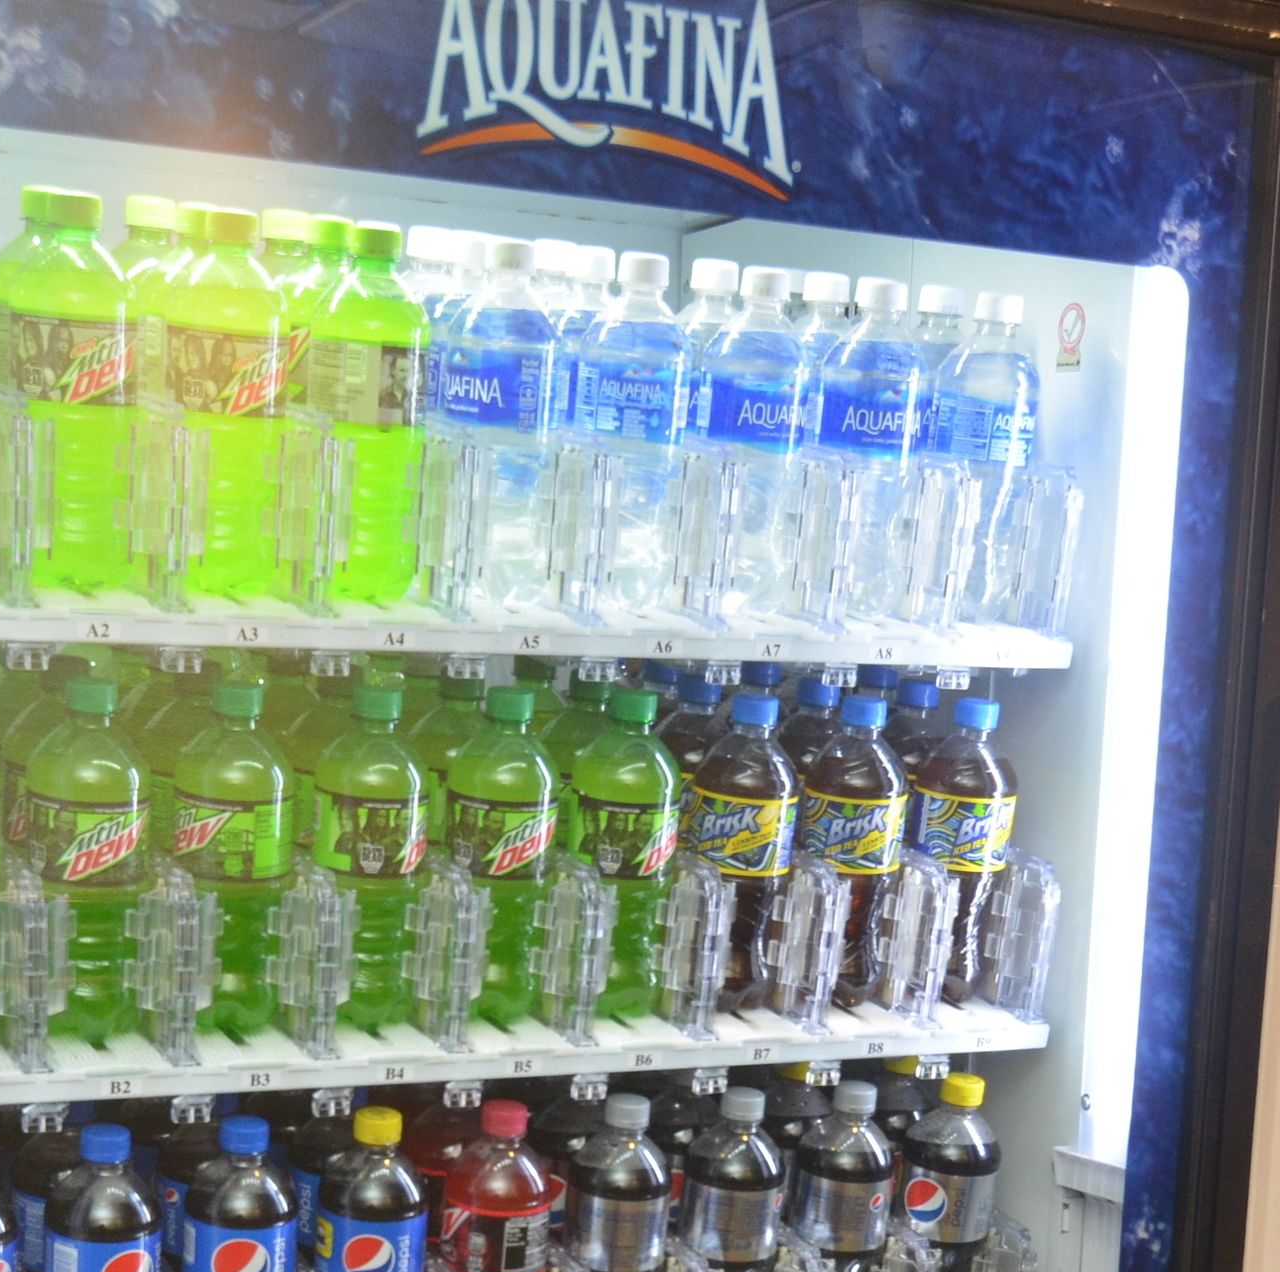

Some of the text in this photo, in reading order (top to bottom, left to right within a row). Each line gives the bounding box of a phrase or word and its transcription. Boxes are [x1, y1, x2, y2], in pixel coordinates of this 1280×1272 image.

[417, 0, 794, 186] AQUAFINA
[86, 623, 111, 638] A2
[236, 627, 260, 641] A3
[383, 632, 406, 646] A4
[519, 636, 541, 650] A5
[652, 640, 673, 653] A6
[760, 643, 781, 657] A7
[873, 646, 893, 660] A8
[753, 1048, 771, 1060] B7
[867, 1043, 884, 1054] B8
[513, 1060, 533, 1073] B5
[634, 1054, 654, 1068] B6
[249, 1073, 272, 1087] B3
[384, 1068, 406, 1081] B4
[110, 1080, 132, 1094] B2
[299, 1182, 313, 1235] pepsi
